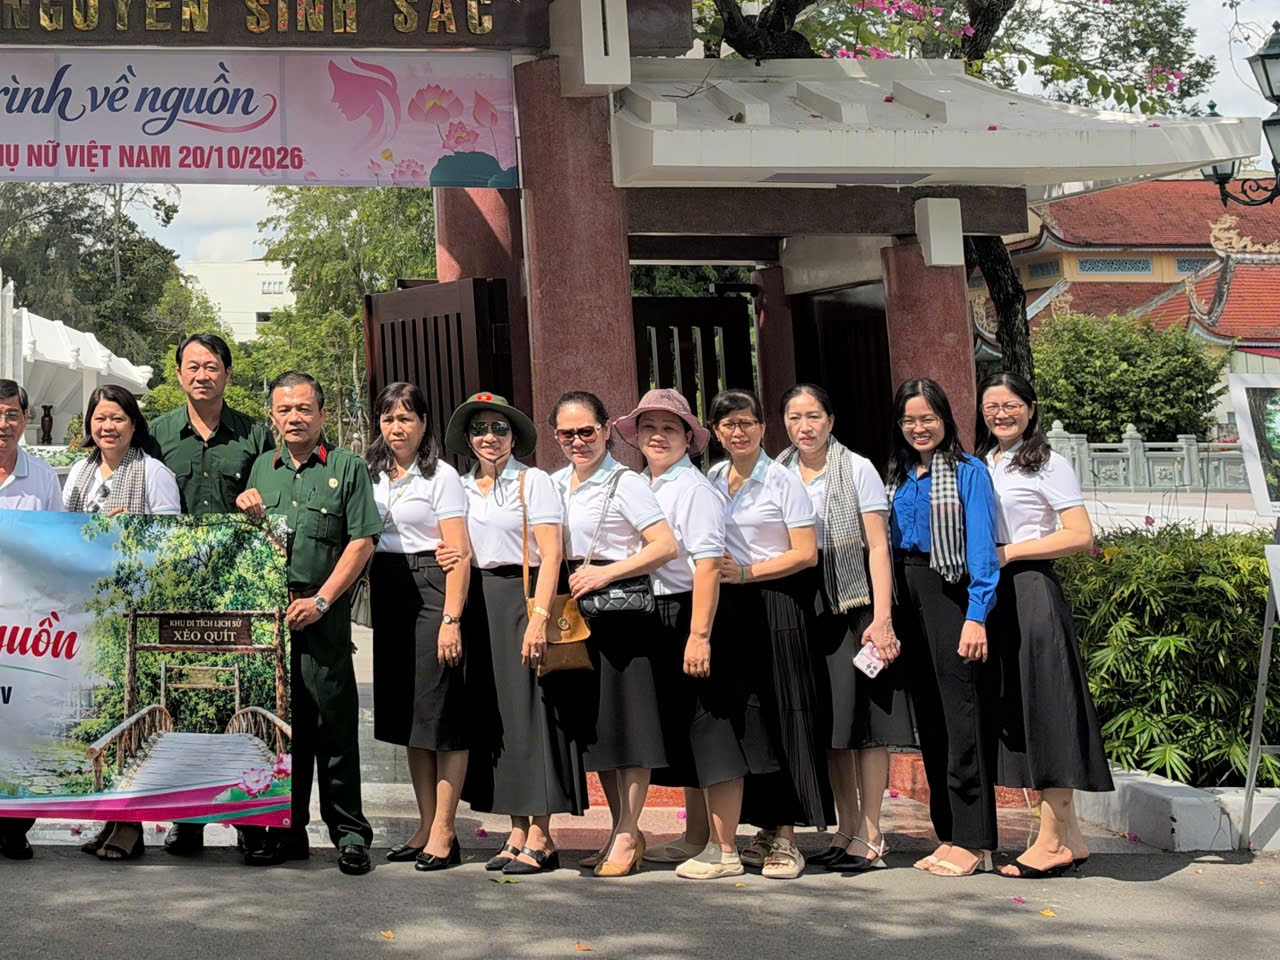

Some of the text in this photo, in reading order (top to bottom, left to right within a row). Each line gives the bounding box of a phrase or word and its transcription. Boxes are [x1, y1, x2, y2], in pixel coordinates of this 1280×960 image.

[85, 64, 137, 113] về
[133, 61, 259, 136] nguồn
[27, 140, 61, 168] NỮ
[65, 140, 112, 173] VIỆT
[118, 145, 171, 168] NAM
[178, 145, 305, 170] 20/10/2026
[196, 618, 213, 628] TÍCH
[204, 628, 237, 643] QUÍT
